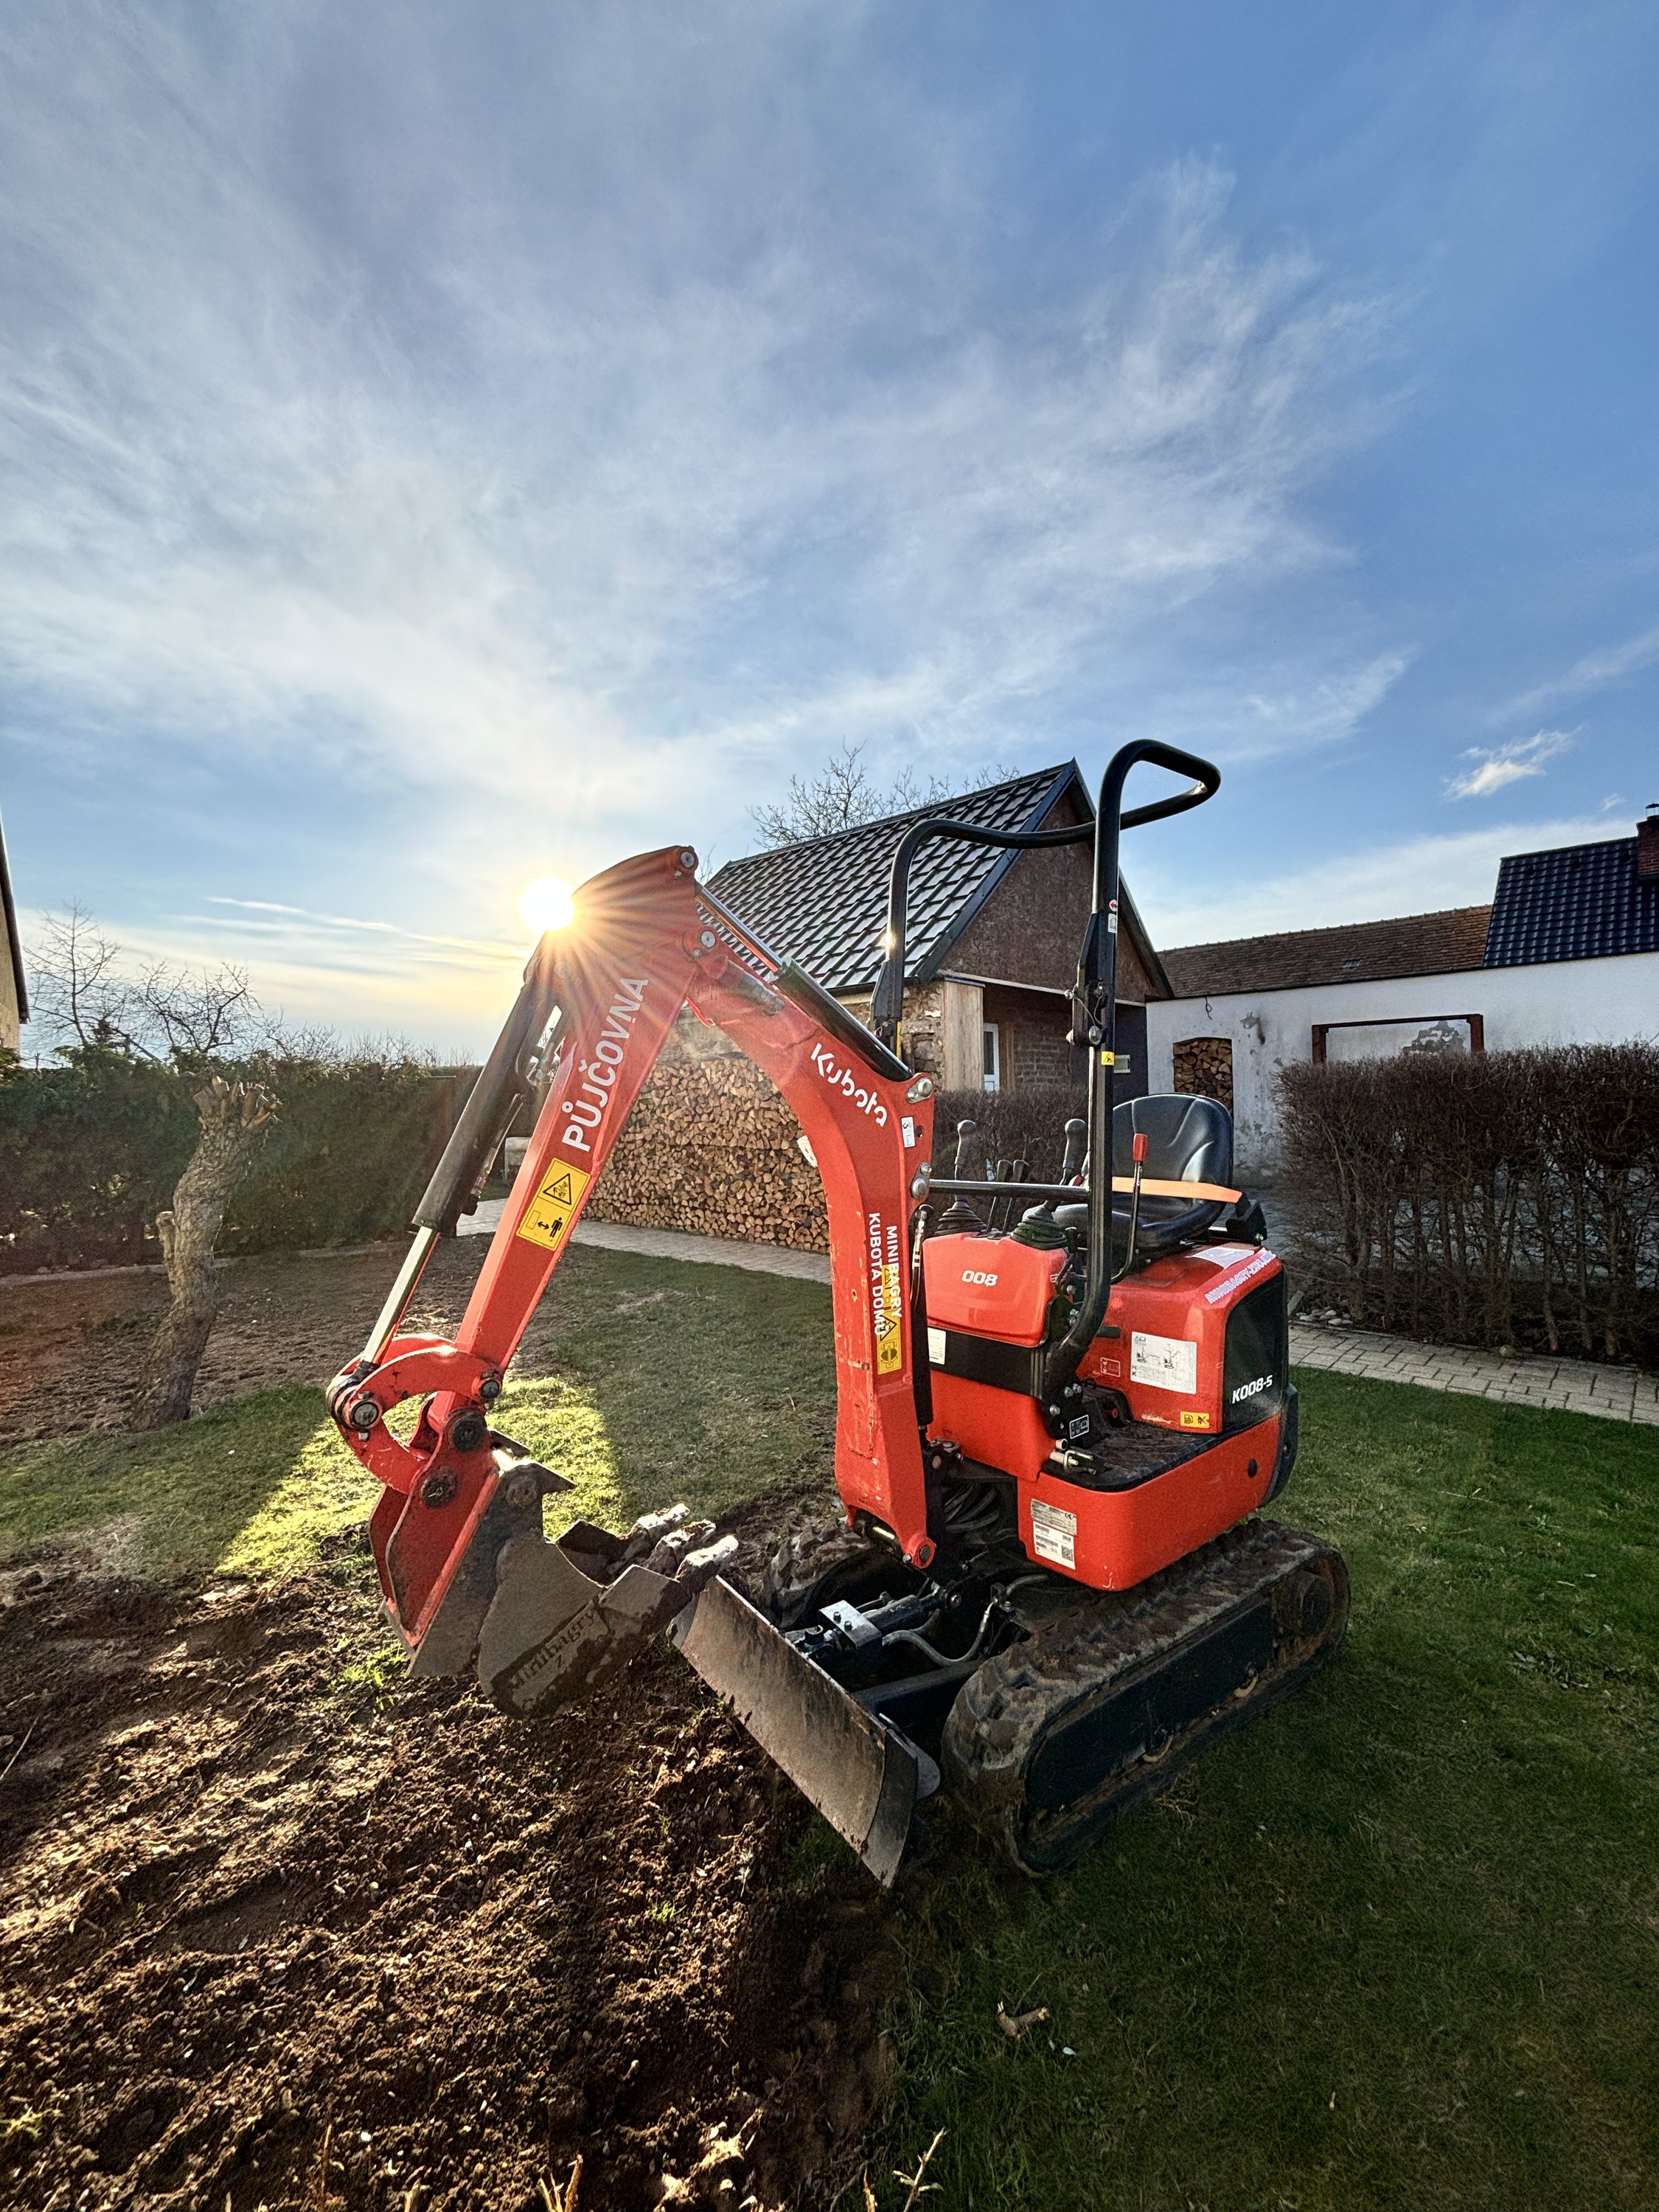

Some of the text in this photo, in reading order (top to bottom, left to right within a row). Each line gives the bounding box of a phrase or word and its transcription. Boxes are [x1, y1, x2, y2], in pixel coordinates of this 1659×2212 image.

[561, 977, 649, 1152] PŮJČOVNA
[810, 1043, 888, 1128] Kubota
[869, 1212, 889, 1337] KUBOTA DOMŮ
[886, 1225, 902, 1318] MINIBAGRY
[961, 1270, 998, 1287] 008
[1231, 1374, 1273, 1404] K008-5
